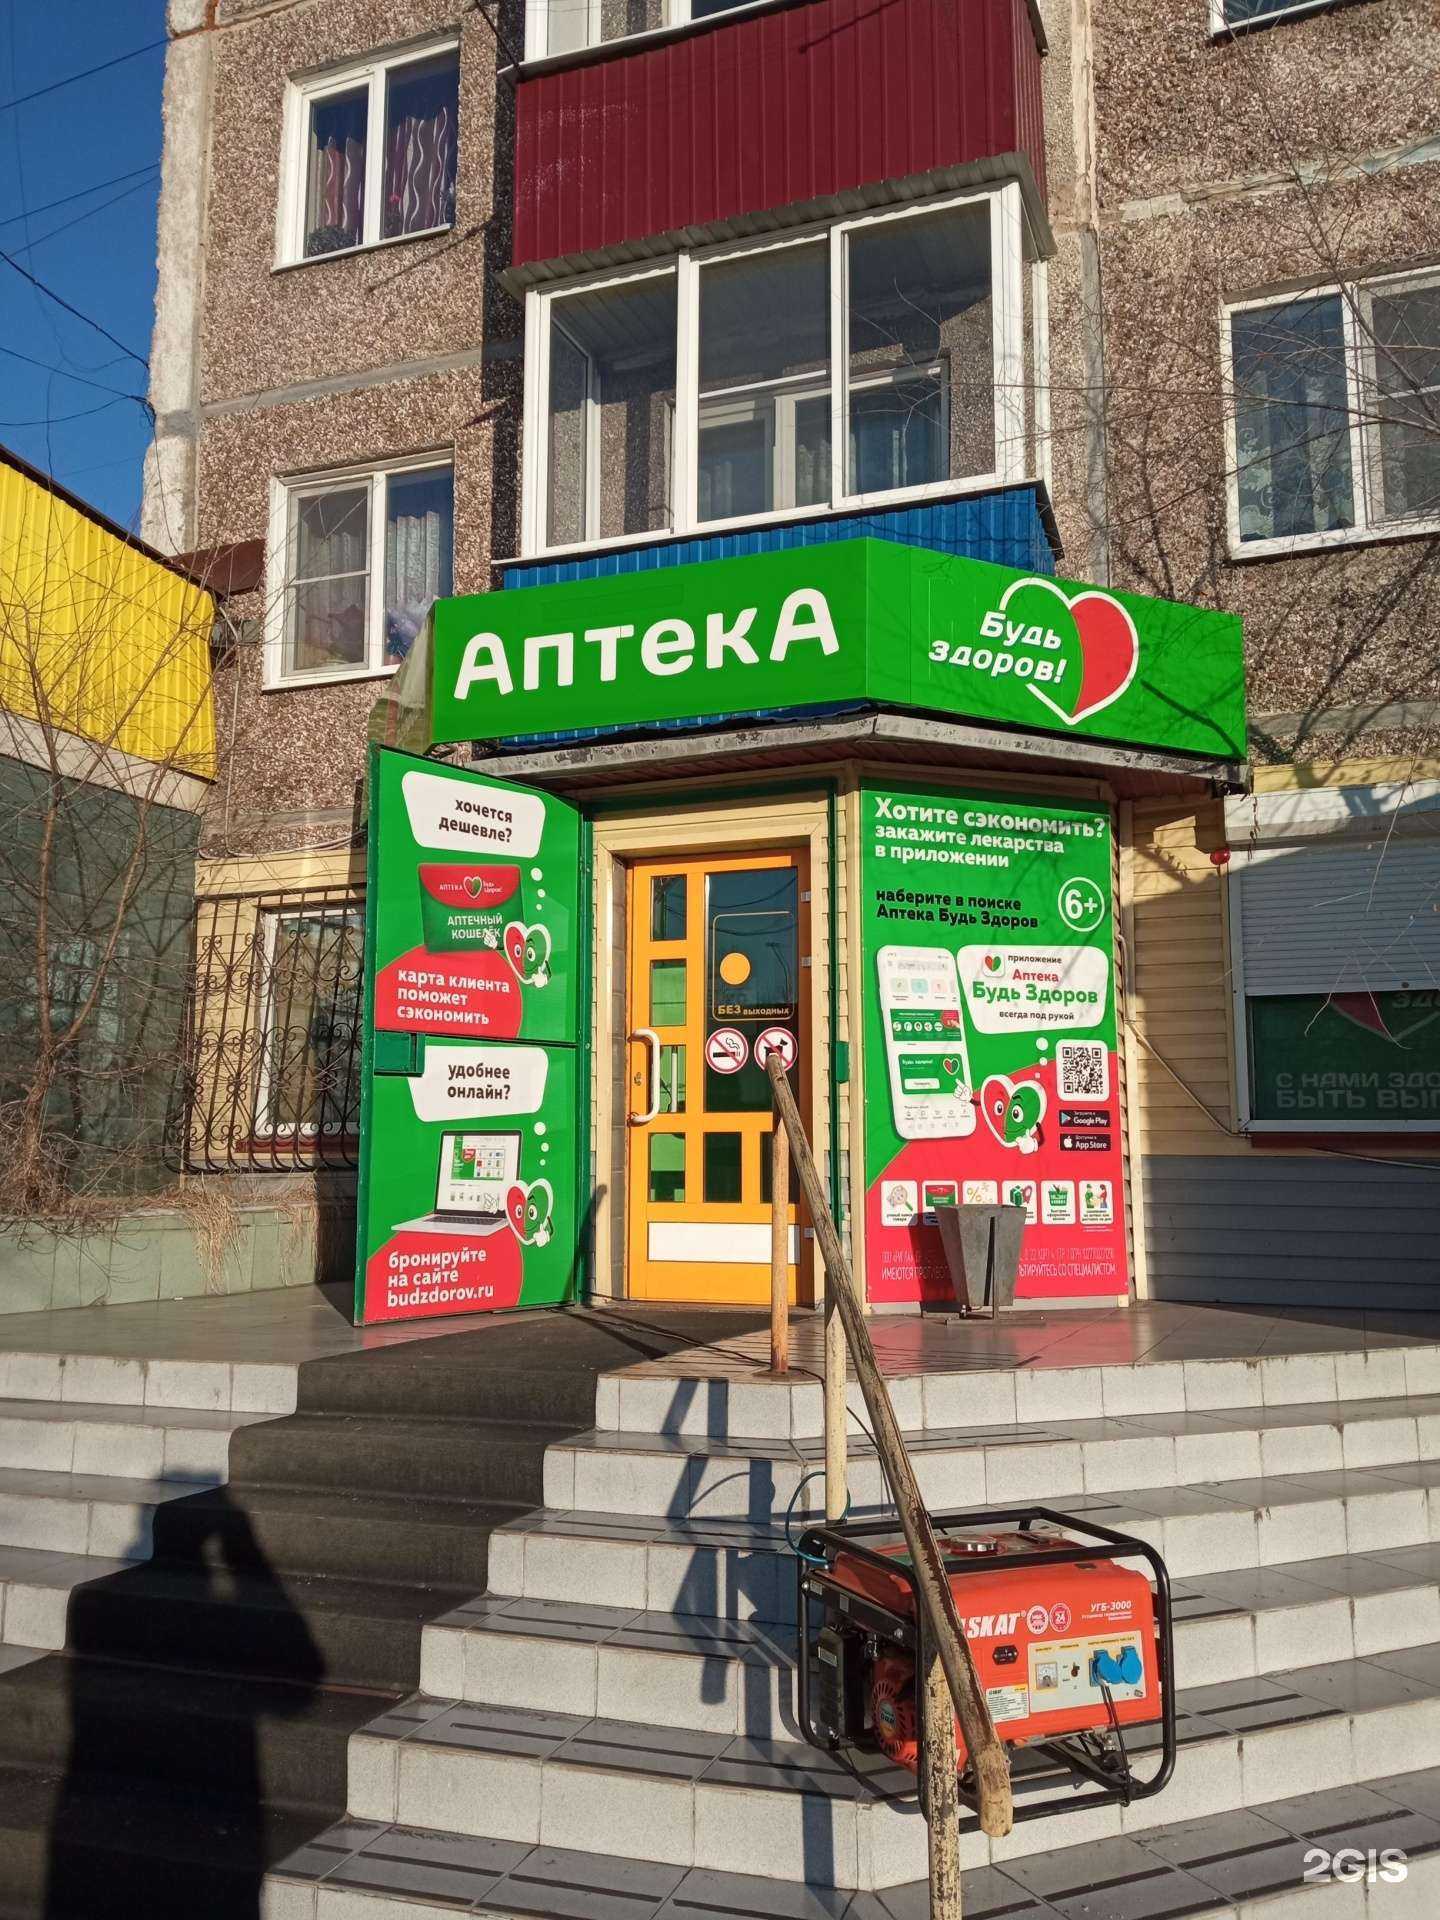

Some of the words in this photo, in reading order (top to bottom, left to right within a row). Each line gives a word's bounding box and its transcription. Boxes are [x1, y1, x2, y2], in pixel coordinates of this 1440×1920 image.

[978, 610, 1063, 651] Будь
[928, 637, 1068, 685] здоров!
[454, 799, 513, 824] хочется
[874, 796, 959, 826] Хотите
[963, 811, 1106, 839] сэкономить?
[438, 815, 513, 843] дешевле?
[874, 824, 967, 846] закажите
[970, 833, 1065, 854] лекарства
[874, 844, 886, 858] в
[890, 846, 1010, 868] приложении
[876, 889, 951, 907] наберите
[955, 896, 964, 907] в
[967, 897, 1021, 911] поиске
[1064, 888, 1098, 920] 6+
[447, 912, 503, 926] АПТЕЧНЫЙ
[876, 904, 935, 922] Аптека
[938, 907, 977, 927] Будь
[981, 912, 1039, 930] Здоров
[1007, 954, 1062, 964] приложение
[398, 969, 445, 988] карта
[448, 975, 510, 993] клиента
[1012, 968, 1059, 983] Аптека
[397, 988, 468, 1006] поможет
[972, 981, 1021, 1004] Будь
[1025, 983, 1098, 1007] Здоров
[397, 1006, 490, 1025] сэкономить
[718, 1004, 741, 1014] БЕЗ
[743, 1007, 789, 1016] выходных
[999, 1010, 1028, 1020] всегда
[1030, 1012, 1047, 1021] под
[1048, 1011, 1075, 1021] рукой
[448, 1063, 511, 1081] удобнее
[1276, 1073, 1293, 1088] С
[1302, 1073, 1379, 1088] НАМИ
[447, 1084, 511, 1101] онлайн?
[1276, 1090, 1367, 1109] БЫТЬ
[1073, 1116, 1095, 1126] Google
[1095, 1117, 1108, 1126] Play
[1075, 1141, 1089, 1150] App
[1089, 1141, 1108, 1149] Store
[388, 1246, 487, 1273] бронируйте
[387, 1274, 409, 1288] на
[413, 1267, 459, 1286] сайте
[387, 1285, 495, 1308] budzdorov.ru
